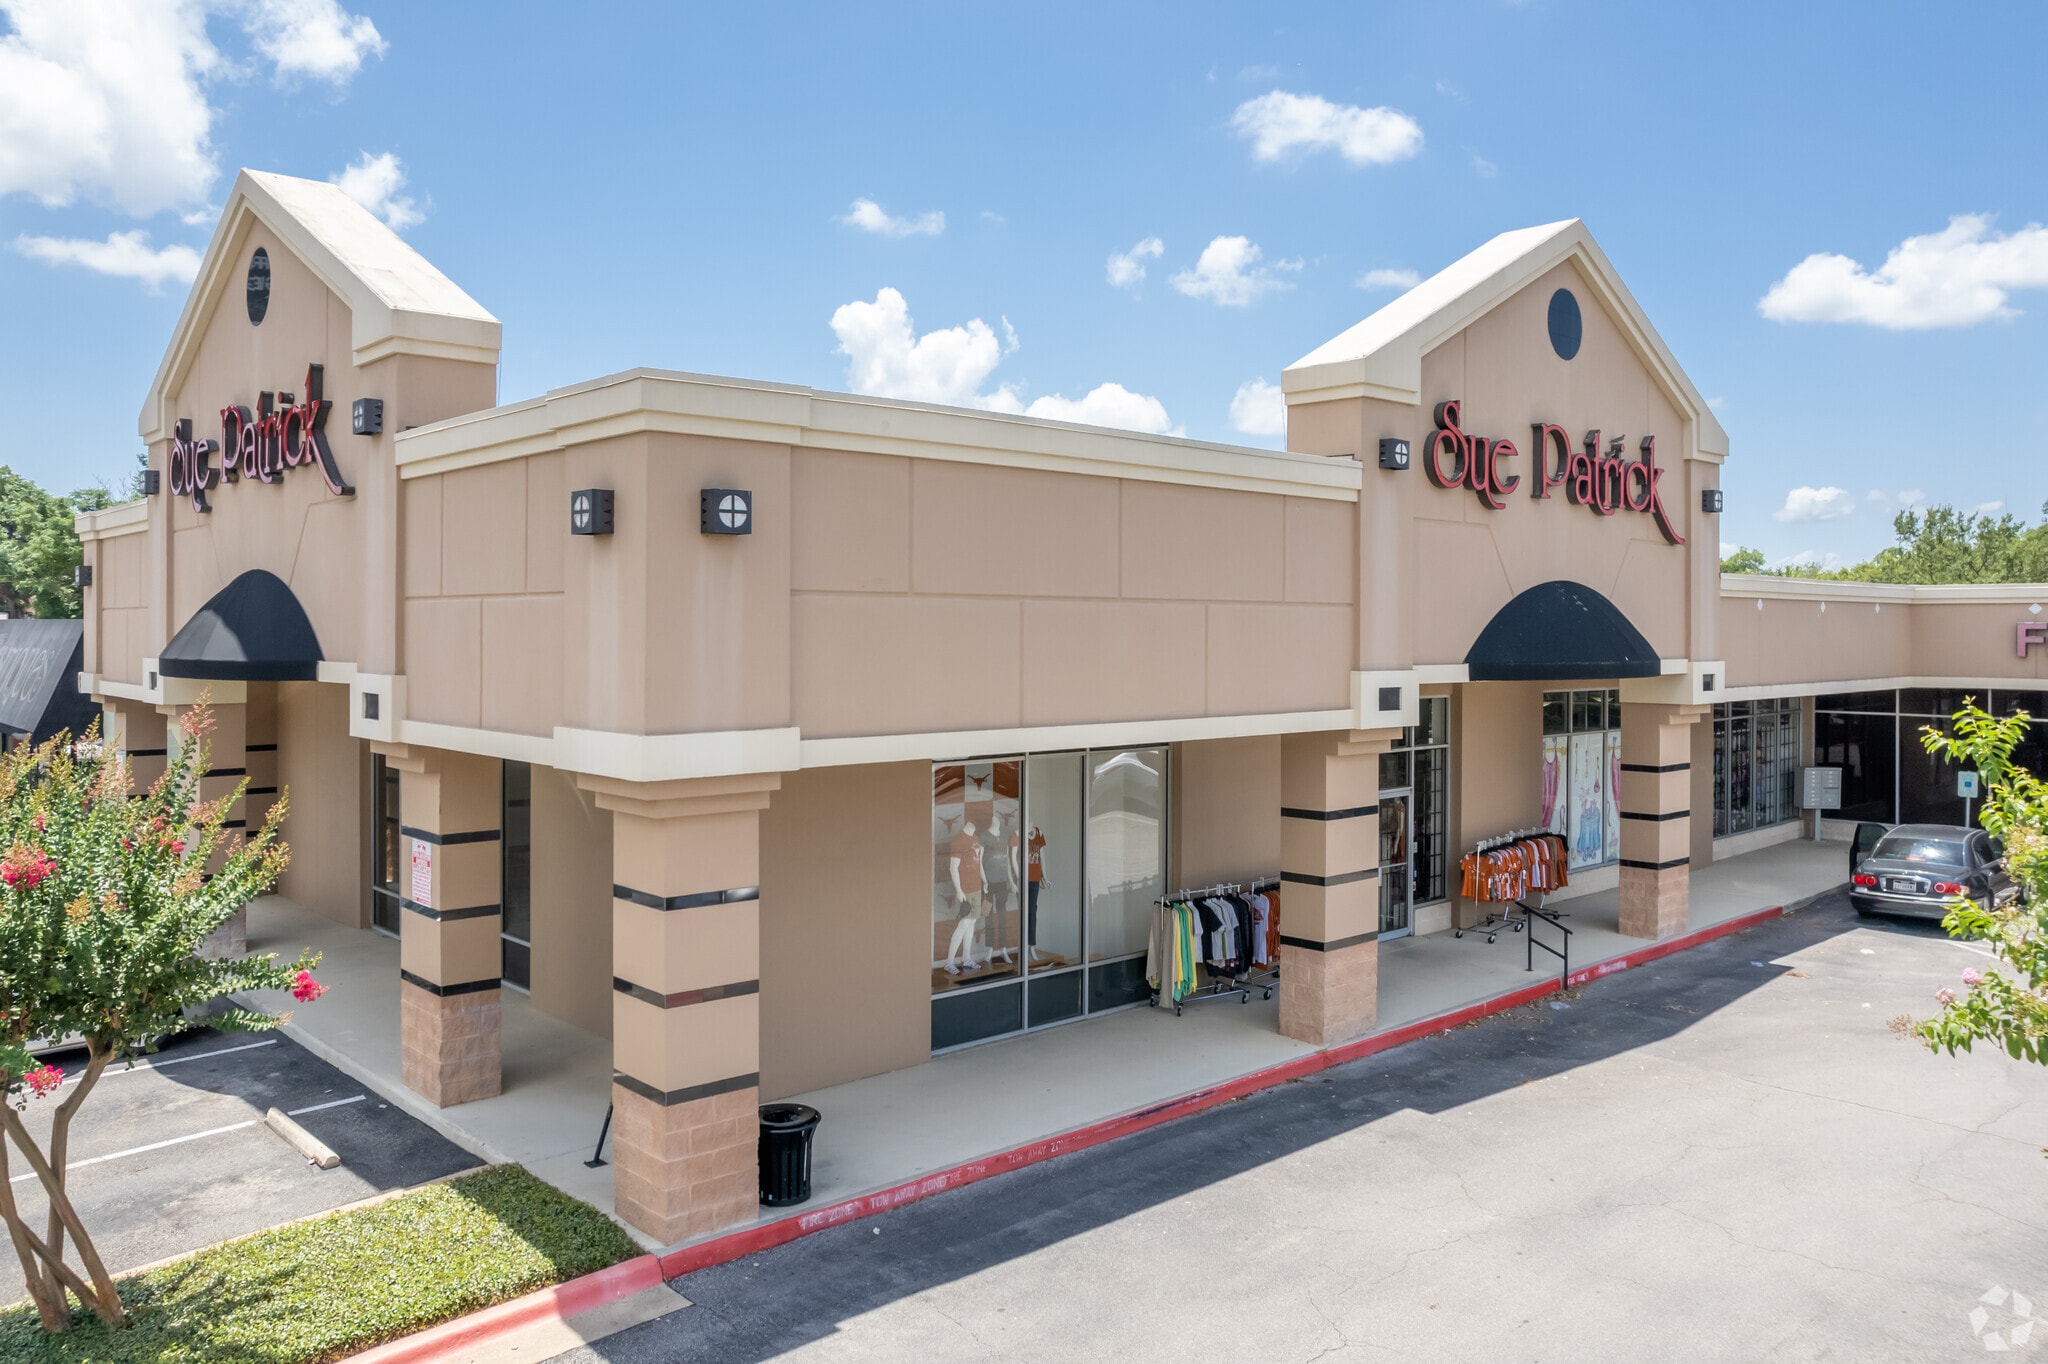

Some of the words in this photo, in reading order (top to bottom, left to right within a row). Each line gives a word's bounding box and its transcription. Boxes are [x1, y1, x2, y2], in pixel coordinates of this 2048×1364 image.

[168, 418, 220, 514] Sue
[220, 362, 355, 496] Patrick
[1423, 400, 1520, 510] Sue
[1531, 422, 1686, 546] Patrick
[870, 1194, 890, 1210] TOW
[894, 1184, 917, 1203] AWAY
